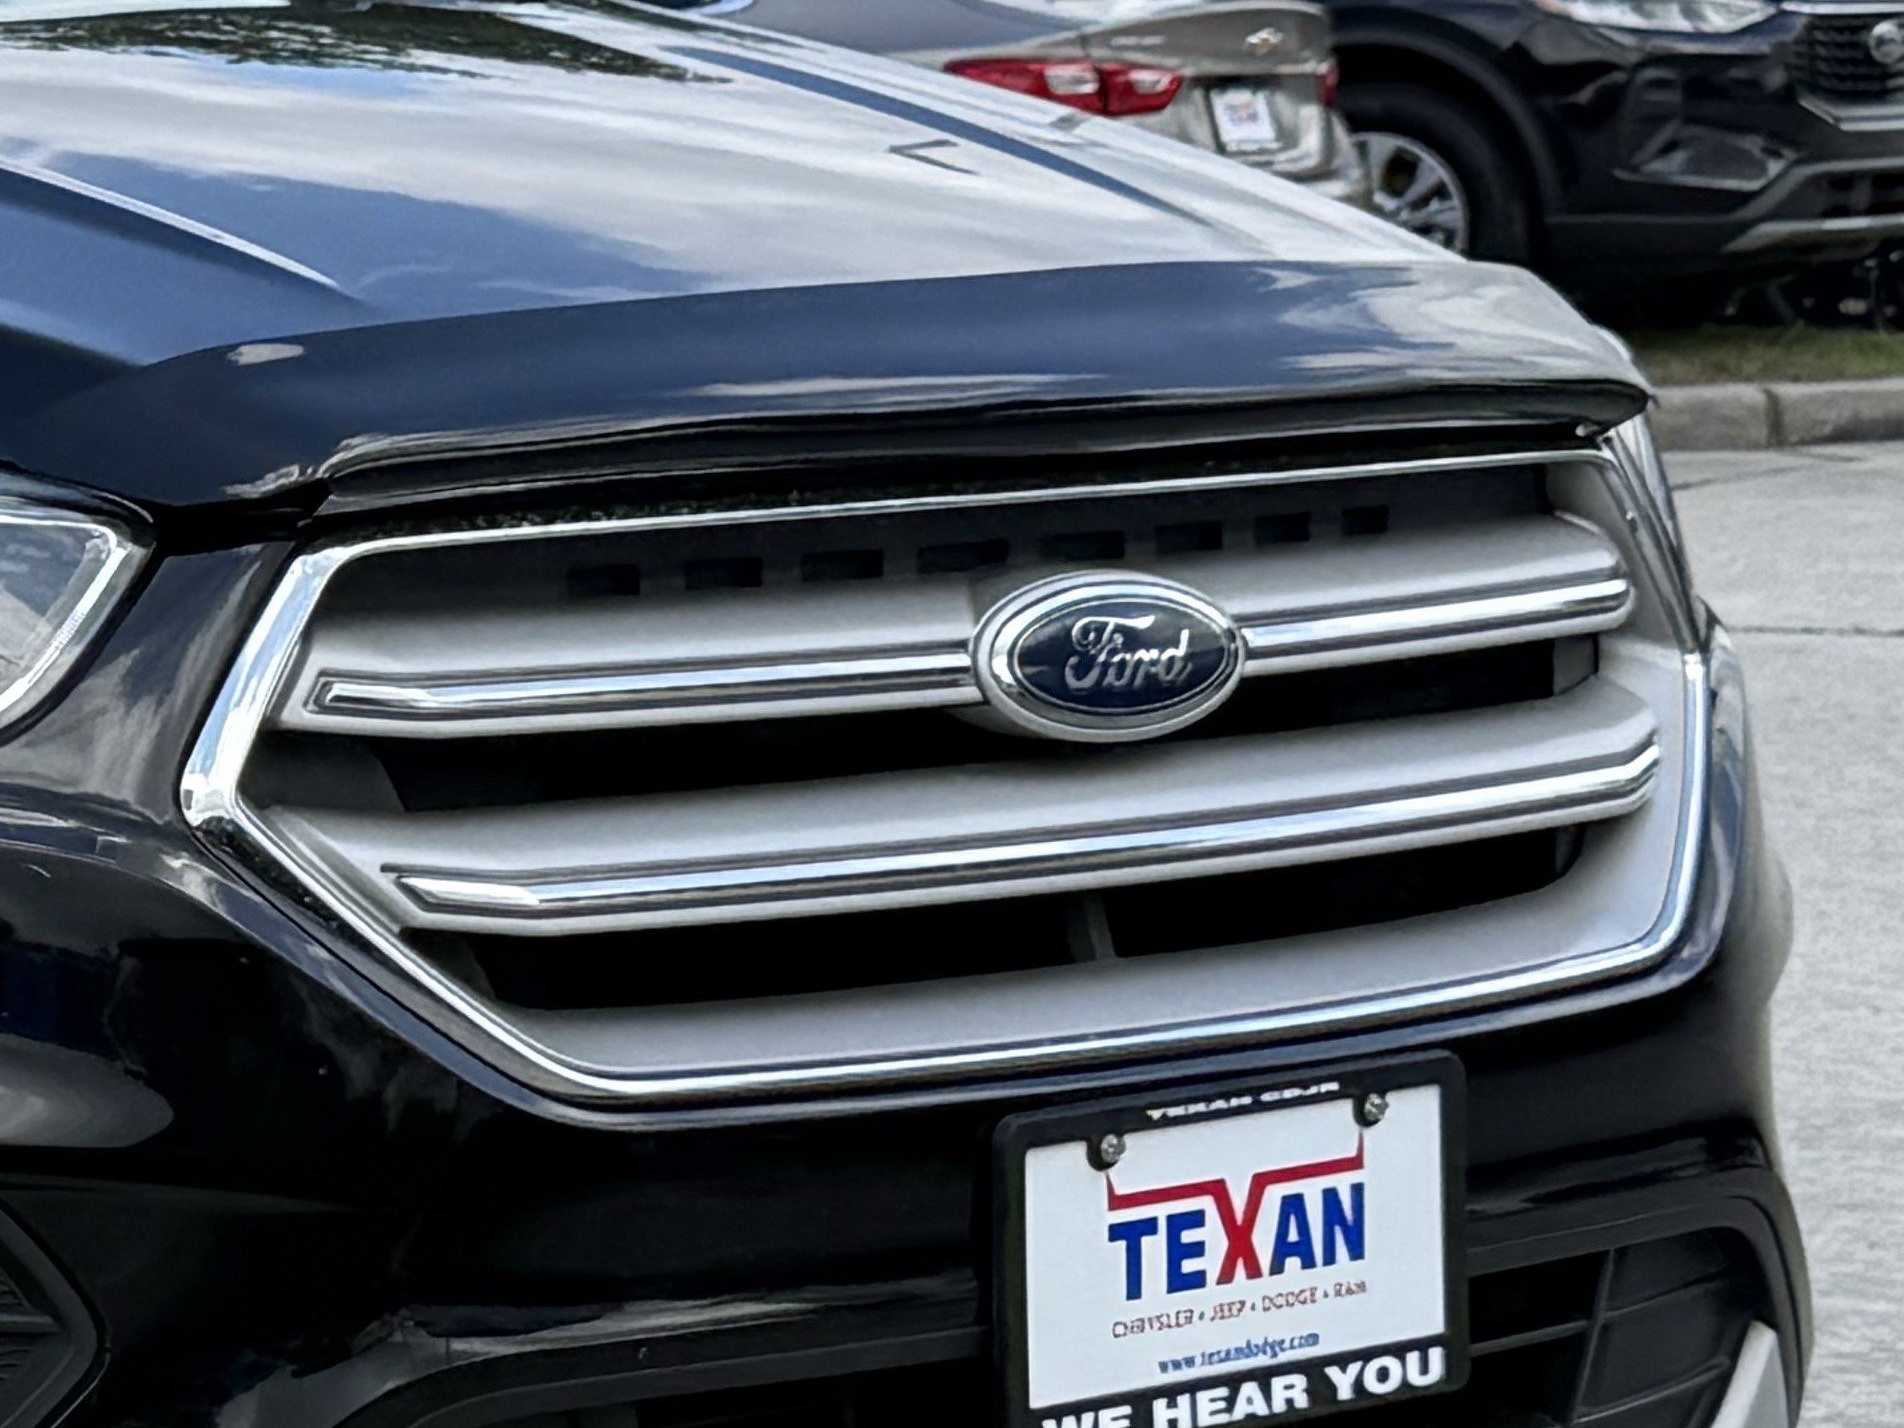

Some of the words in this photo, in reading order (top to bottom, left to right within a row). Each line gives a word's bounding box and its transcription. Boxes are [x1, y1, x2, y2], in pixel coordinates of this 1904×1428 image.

[1064, 614, 1193, 692] Ford
[1107, 1162, 1366, 1301] TEXAN
[1111, 1308, 1195, 1339] CHRYSLER
[1262, 1286, 1319, 1312] DODGE
[1333, 1280, 1368, 1298] RAM
[1157, 1332, 1320, 1374] www.texandodge.com
[1324, 1346, 1446, 1401] YOU
